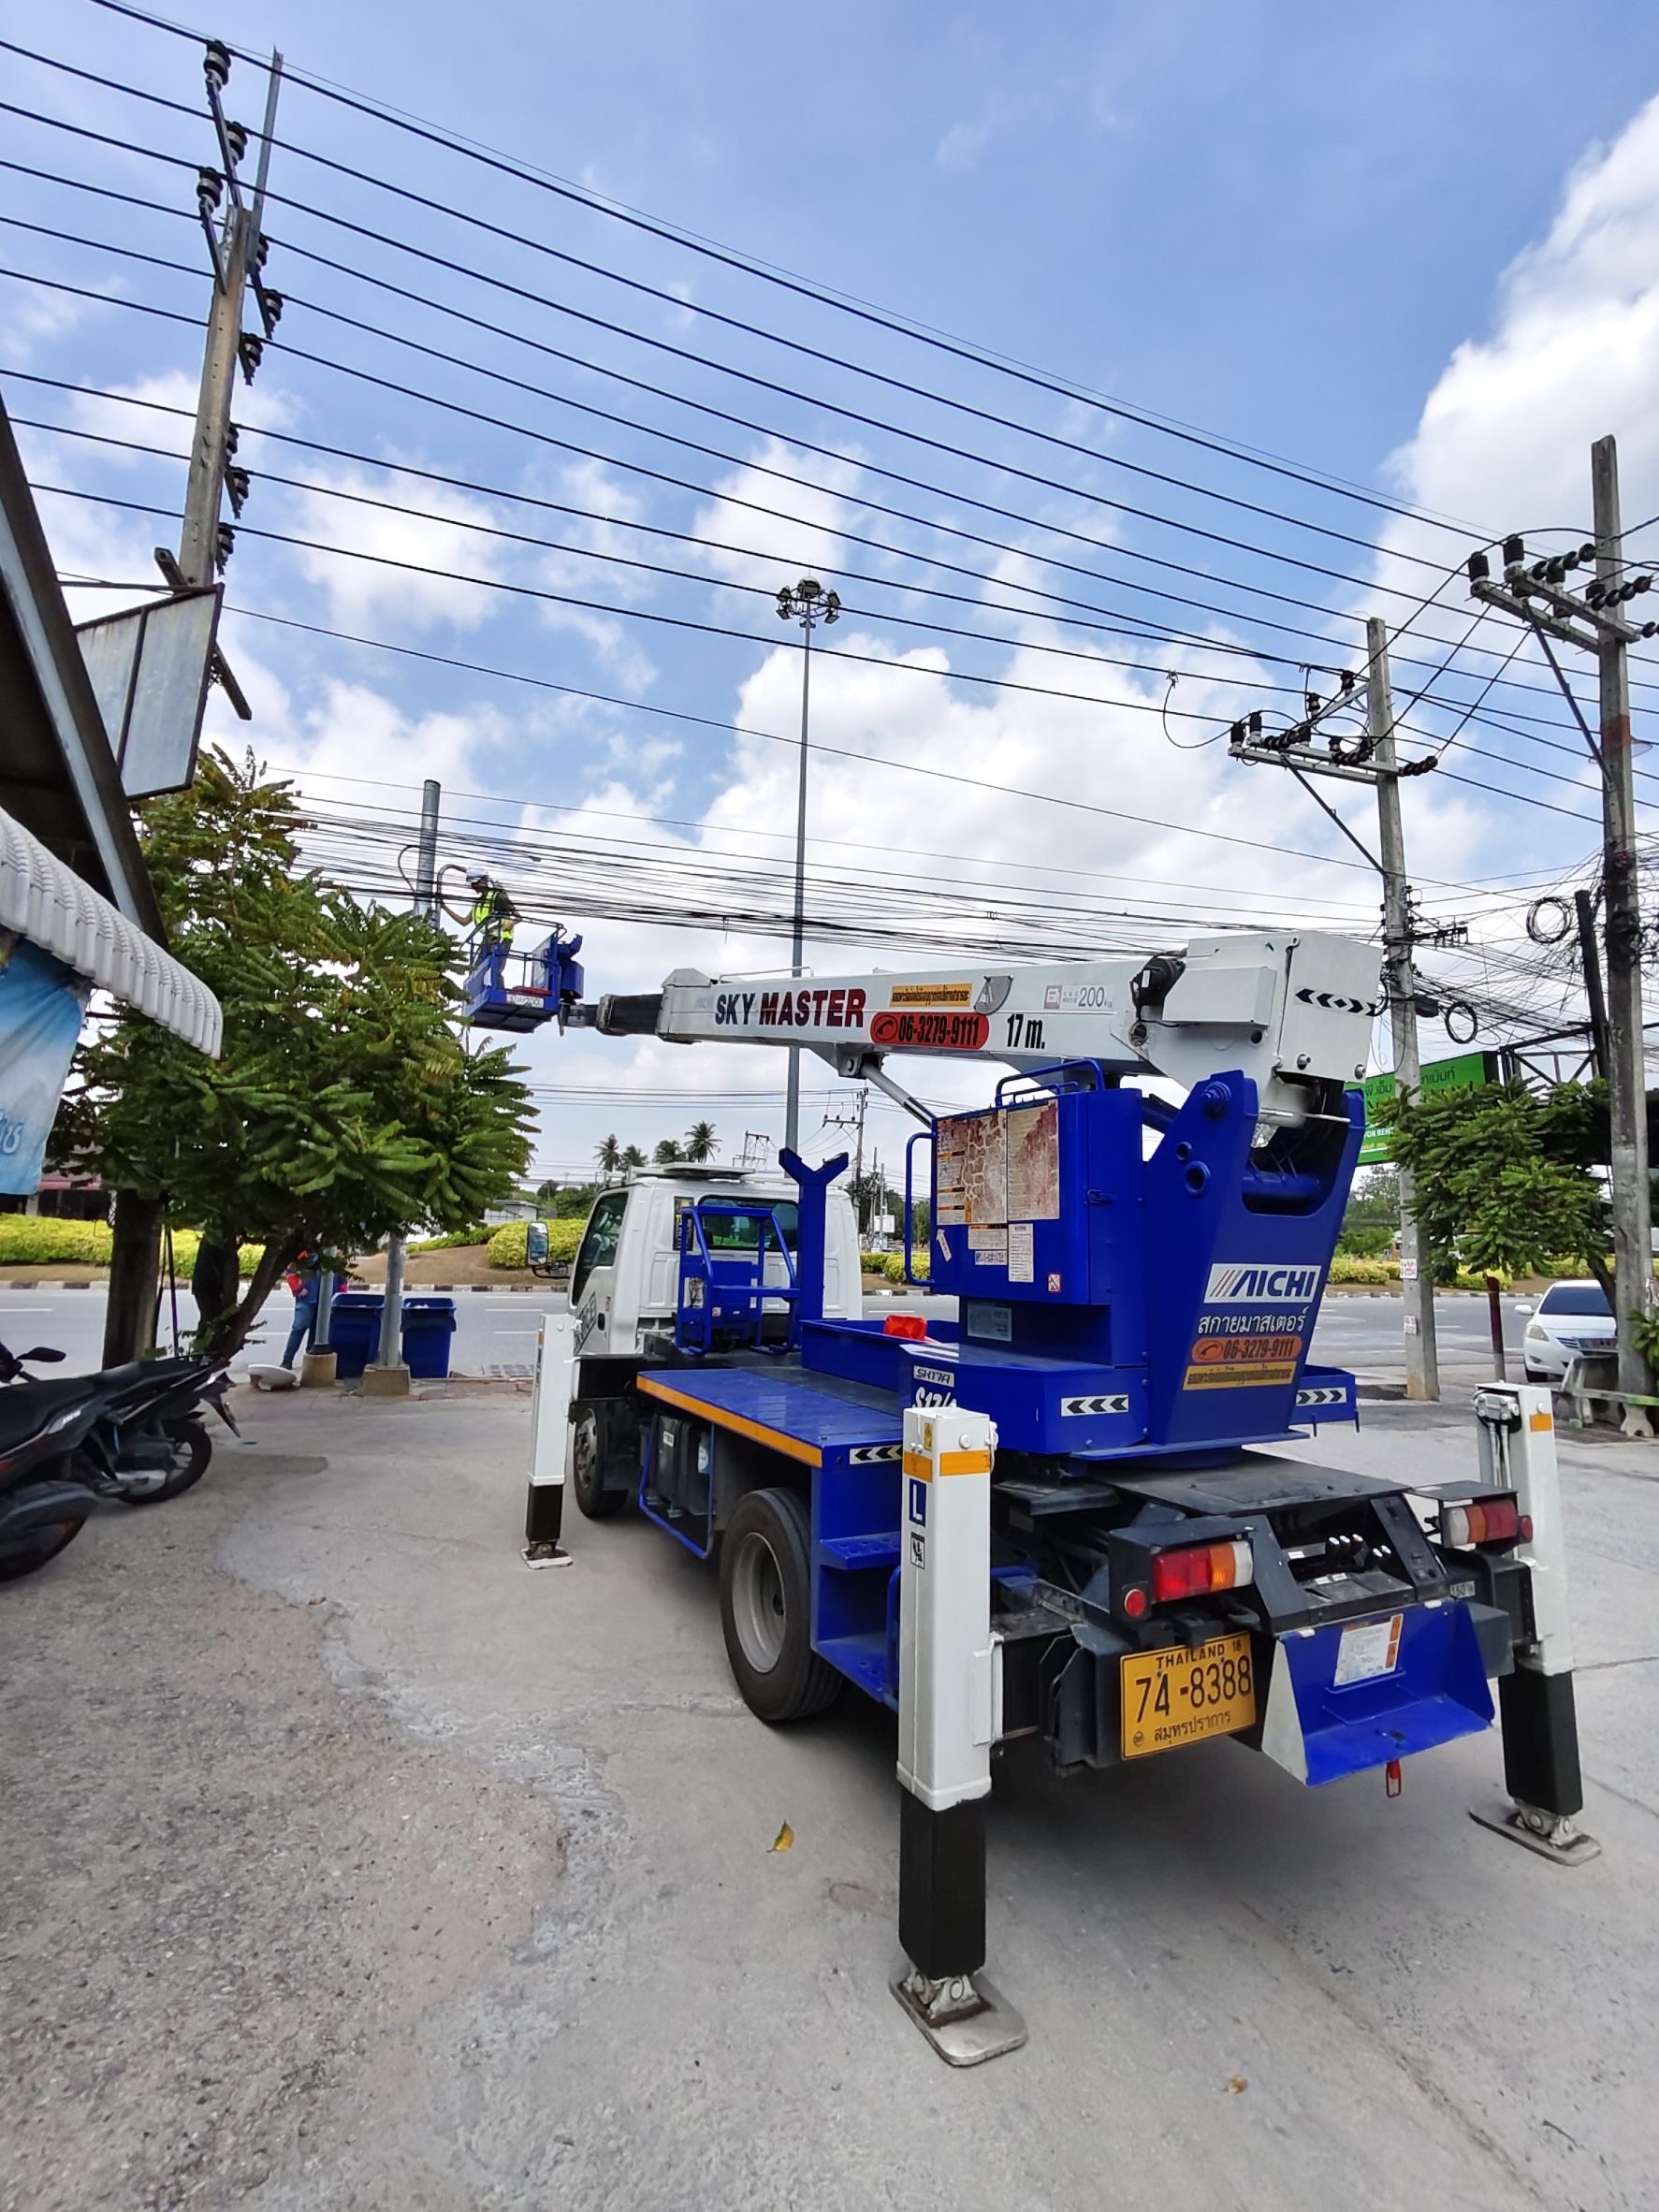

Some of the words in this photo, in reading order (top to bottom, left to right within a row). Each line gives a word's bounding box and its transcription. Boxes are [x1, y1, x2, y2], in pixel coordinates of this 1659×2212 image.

[715, 993, 756, 1026] SKY
[759, 988, 866, 1028] MASTER
[1078, 986, 1104, 1008] 200
[897, 1013, 981, 1045] 06-3279-9111
[1007, 1013, 1024, 1048] 17
[1227, 1270, 1317, 1298] AICHI
[1197, 1305, 1310, 1334] สกายมาสเตอร์
[1223, 1337, 1296, 1361] 06-3279-9111
[916, 1368, 952, 1385] SK17A
[1156, 1643, 1226, 1669] THAILAND
[1135, 1654, 1252, 1724] 74-8388
[1153, 1710, 1232, 1745] สมุทรปราการ
